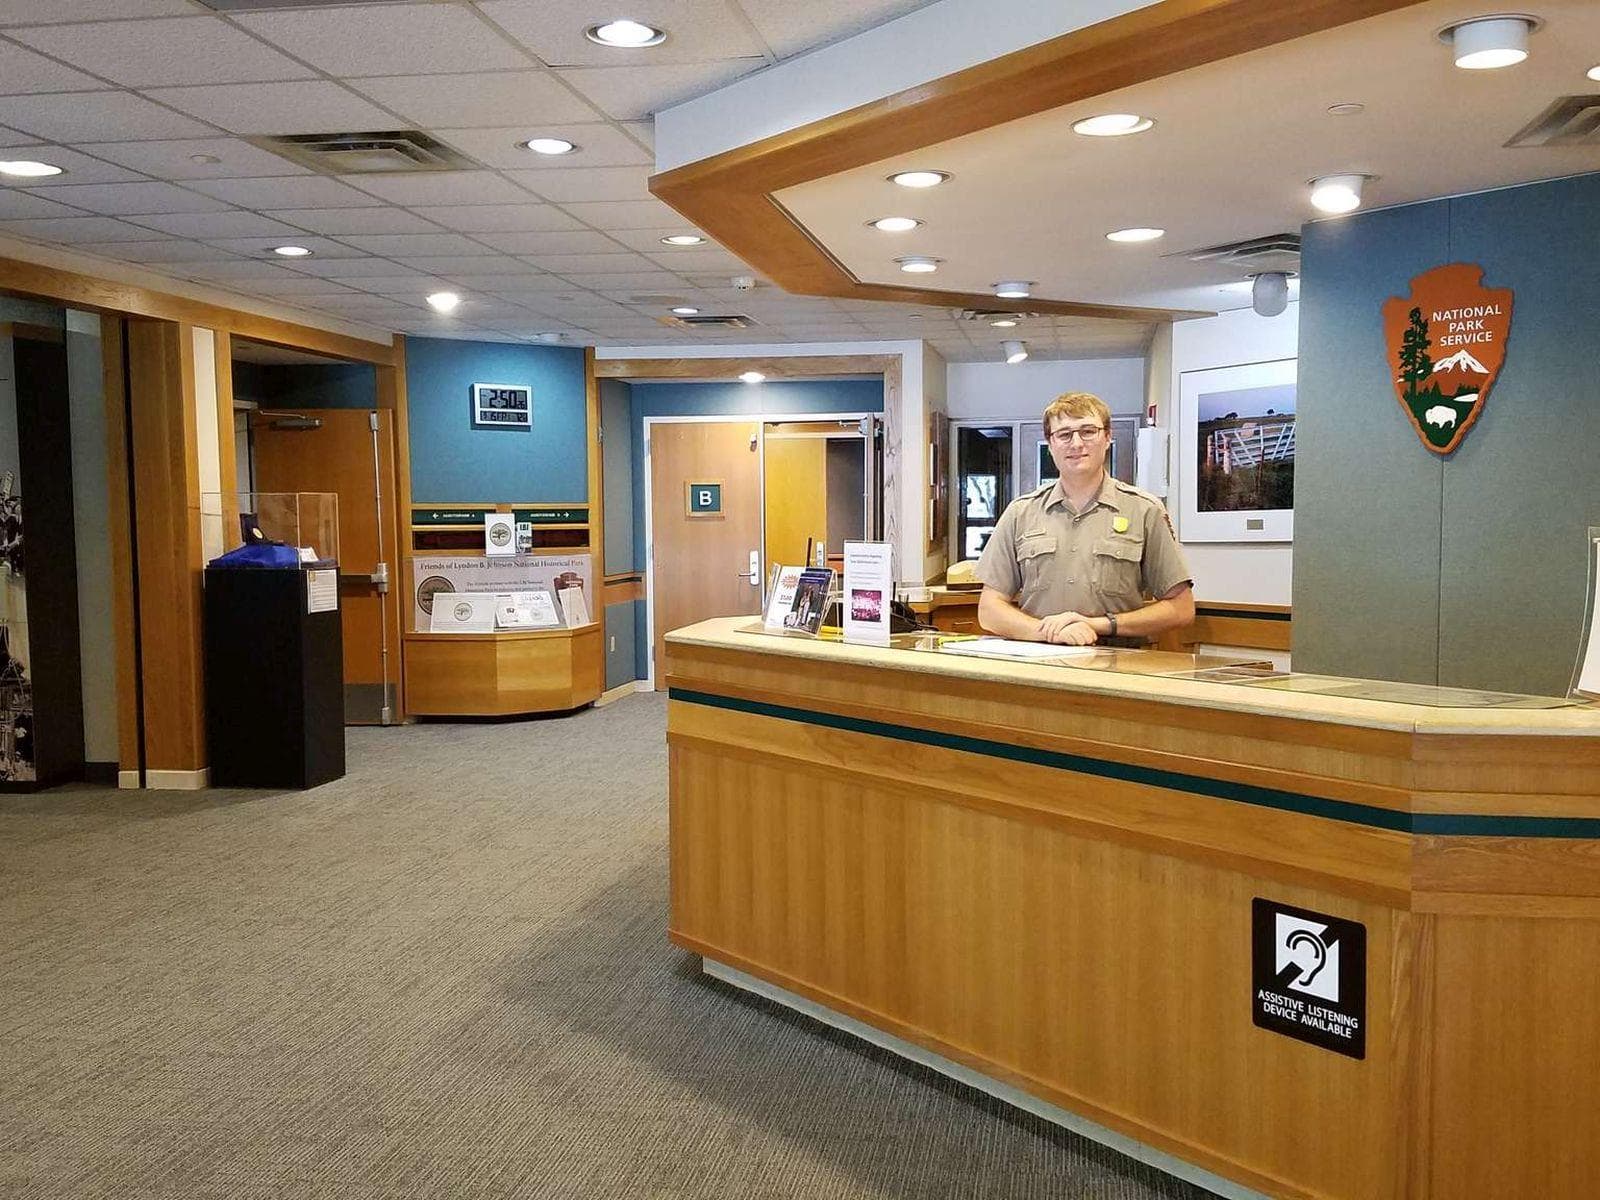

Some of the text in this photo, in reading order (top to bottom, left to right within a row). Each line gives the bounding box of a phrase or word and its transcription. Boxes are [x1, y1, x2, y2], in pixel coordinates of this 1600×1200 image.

[1432, 304, 1502, 322] NATIONAL
[1449, 319, 1484, 333] PARK
[1440, 331, 1493, 347] SERVICE
[699, 490, 712, 506] B
[420, 562, 445, 570] Friends
[1258, 989, 1358, 1029] ASSISTIVE LISTENING
[1263, 1002, 1352, 1039] DEVICE AVAILABLE
